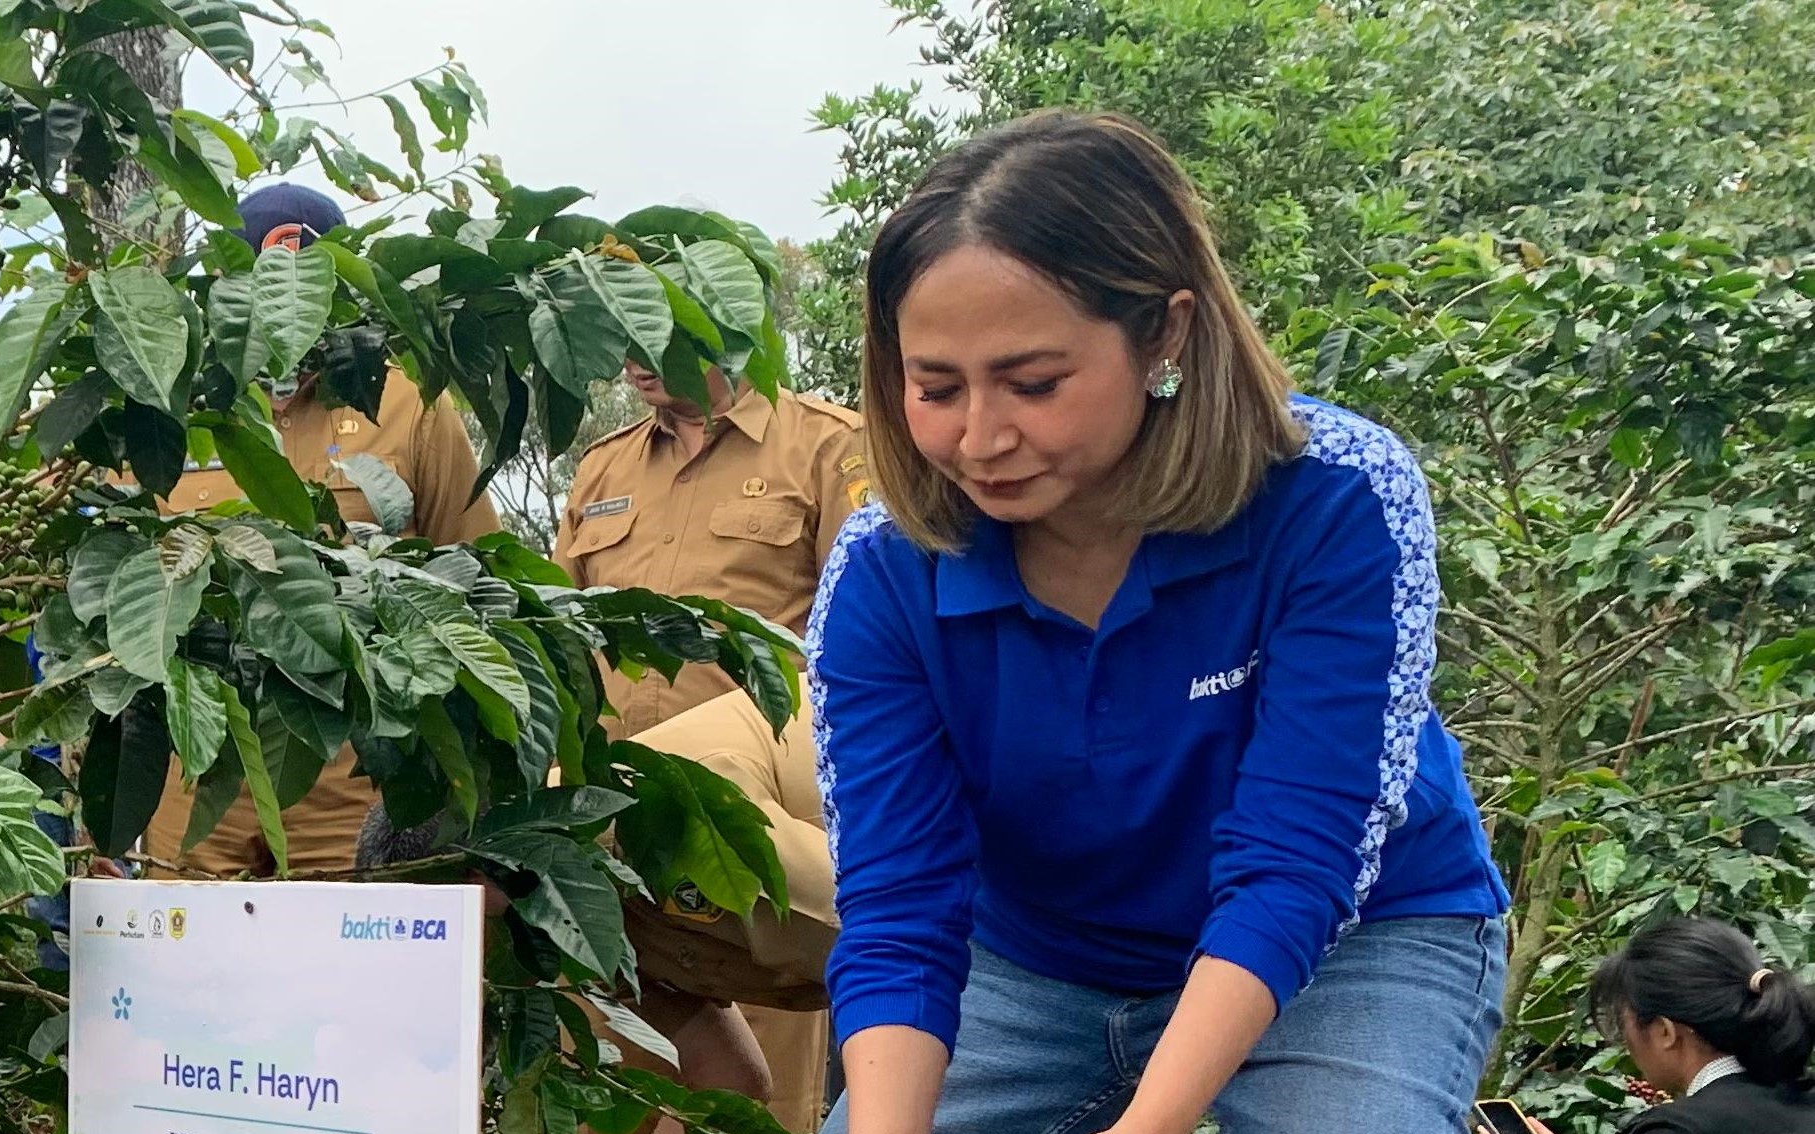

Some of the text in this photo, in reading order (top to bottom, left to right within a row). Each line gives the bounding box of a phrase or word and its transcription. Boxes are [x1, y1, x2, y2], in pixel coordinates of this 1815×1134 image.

[340, 912, 446, 940] bakti BCA
[163, 1053, 339, 1112] Hera F. Haryn
